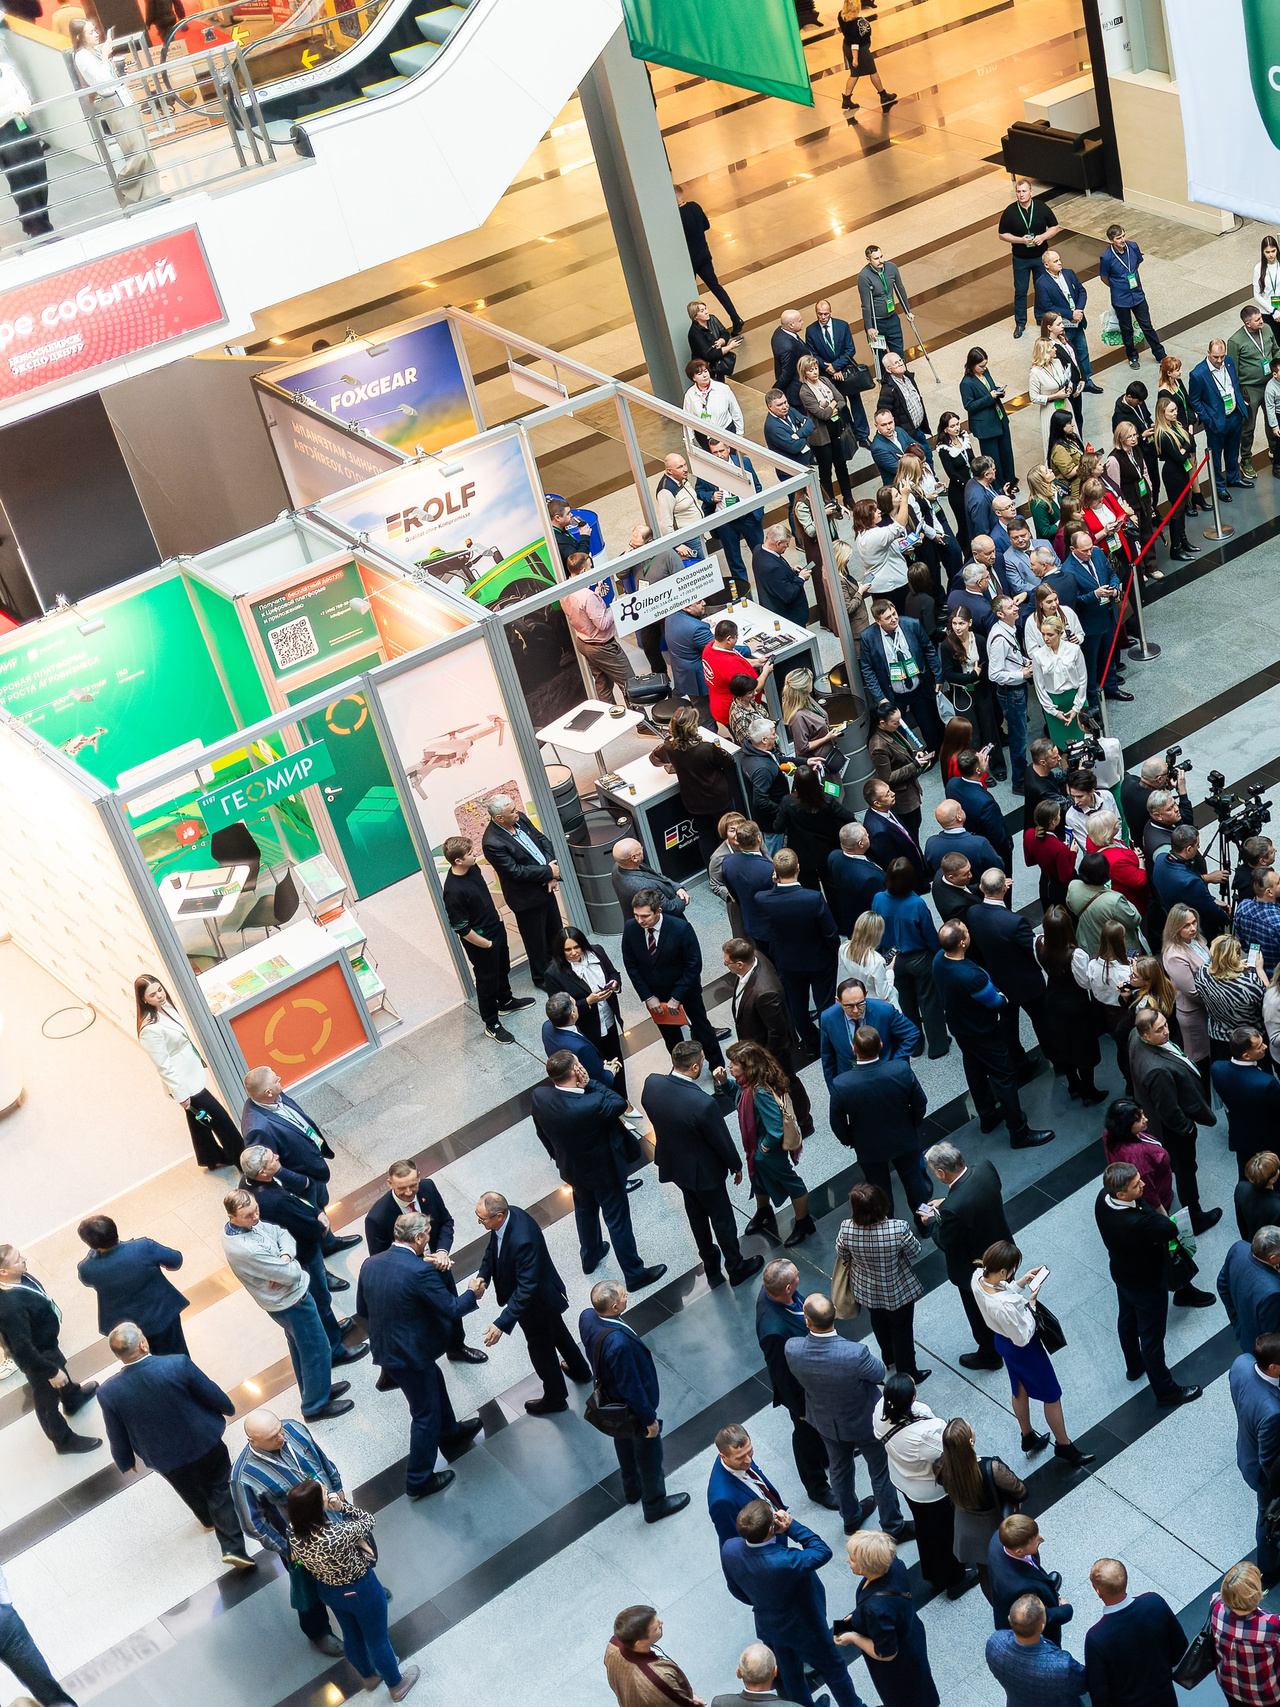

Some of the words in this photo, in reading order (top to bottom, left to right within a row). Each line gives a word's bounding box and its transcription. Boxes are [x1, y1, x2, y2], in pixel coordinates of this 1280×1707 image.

[41, 257, 177, 326] событий
[8, 332, 83, 367] НОВОСИБИРСК
[11, 355, 49, 376] ЭКСПО
[50, 343, 85, 364] ЦЕНТР
[330, 366, 418, 413] FOXGEAR
[675, 563, 713, 585] Смазочные
[678, 571, 714, 592] материалы
[634, 588, 673, 612] Oilberry
[654, 594, 698, 619] shop.oilberry.ru
[7, 685, 37, 702] РОСТА
[38, 656, 100, 689] АГРОБИЗНЕСА
[33, 651, 88, 679] ПЛАТФОРМА
